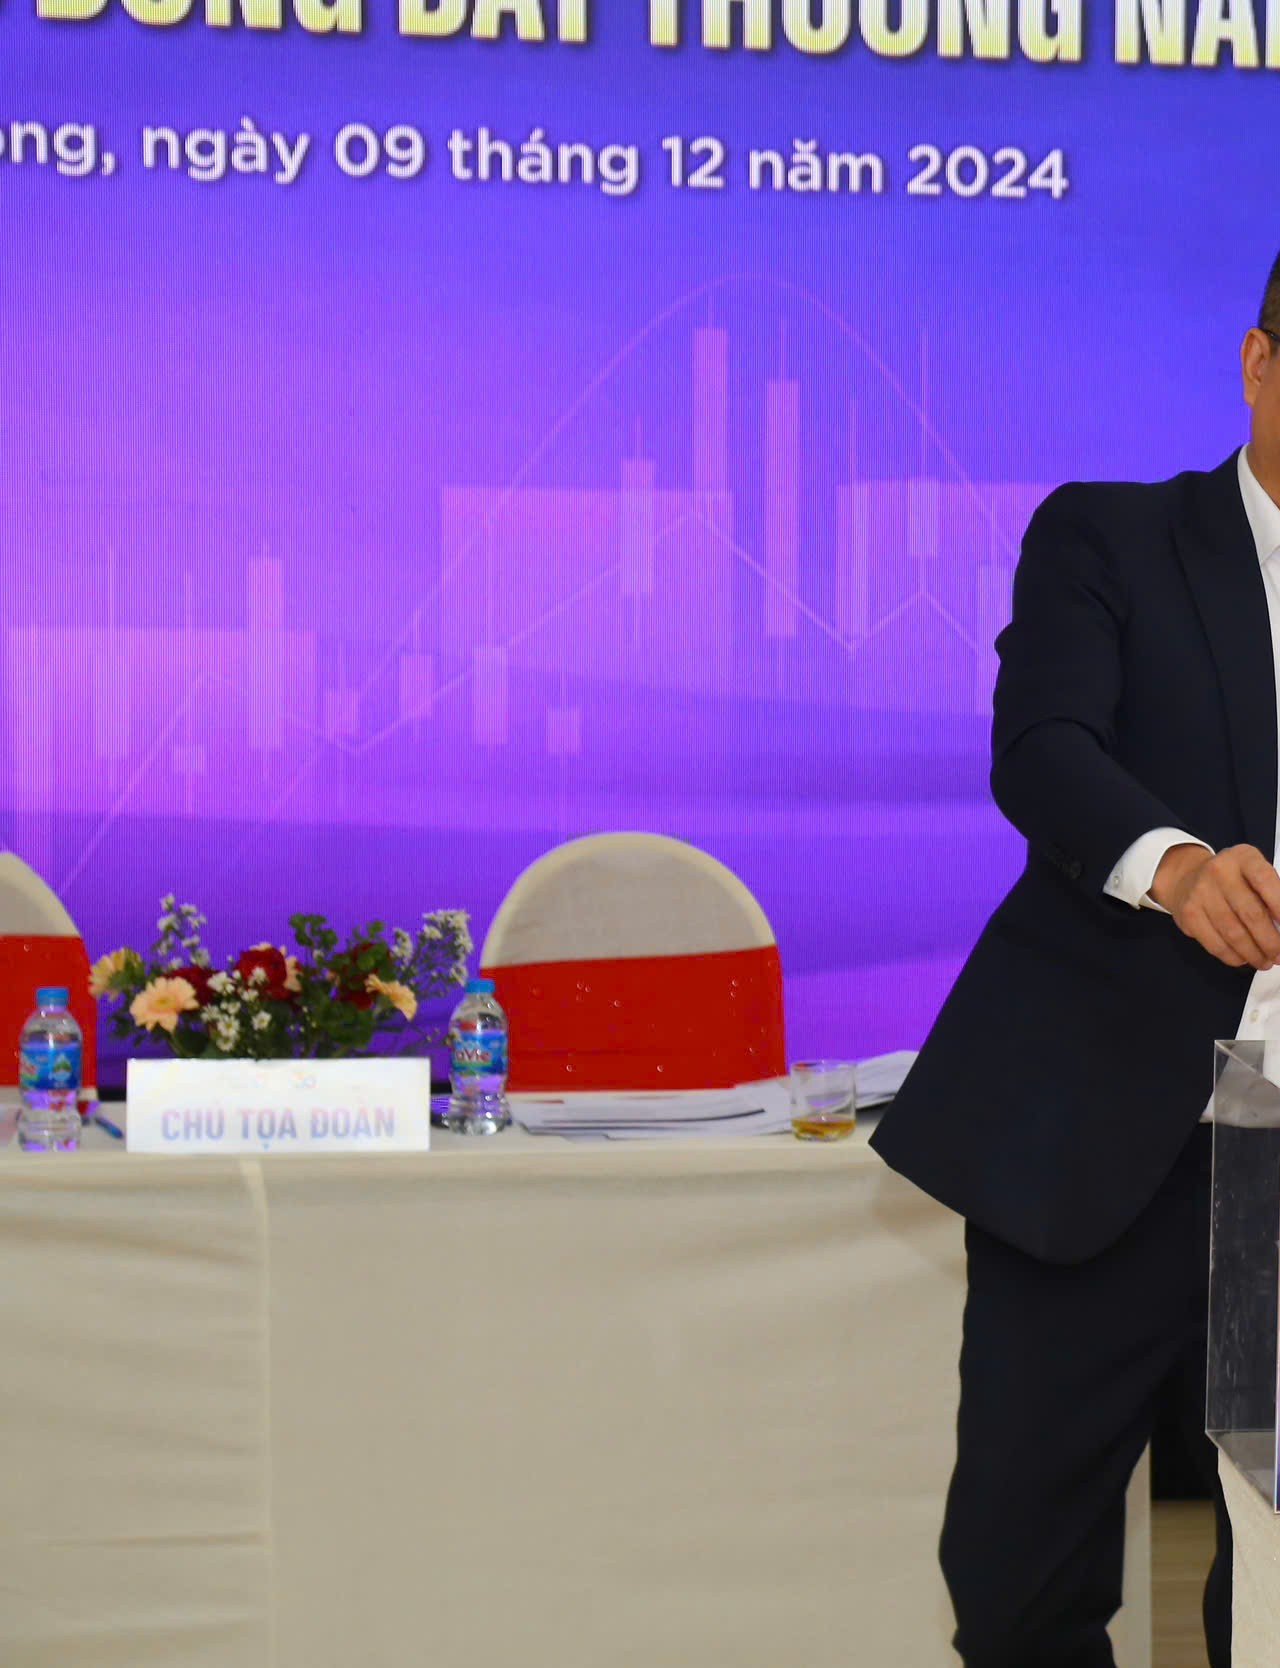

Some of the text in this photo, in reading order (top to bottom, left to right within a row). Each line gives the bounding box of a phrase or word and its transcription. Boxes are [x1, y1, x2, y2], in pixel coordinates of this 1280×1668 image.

[0, 115, 1069, 200] ng, ngày 09 tháng 12 năm 2024
[238, 1105, 298, 1150] TỌA
